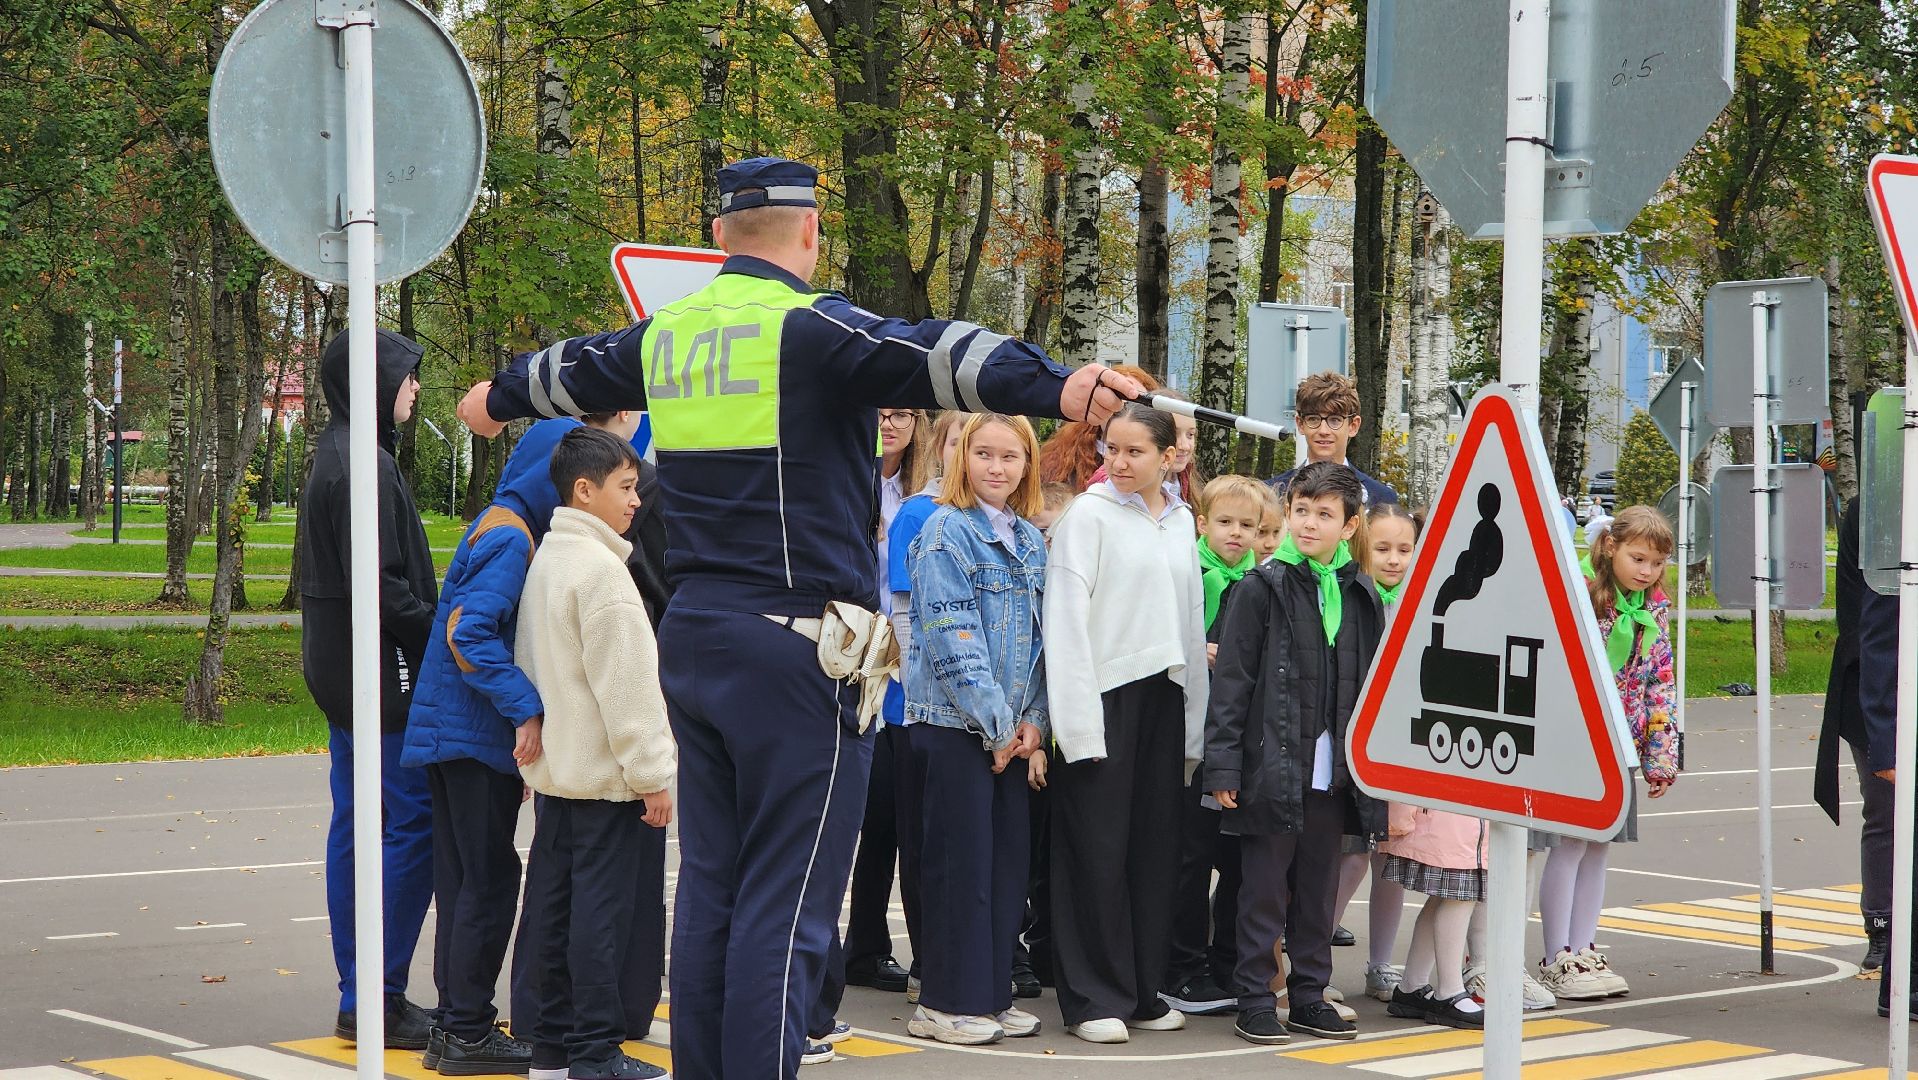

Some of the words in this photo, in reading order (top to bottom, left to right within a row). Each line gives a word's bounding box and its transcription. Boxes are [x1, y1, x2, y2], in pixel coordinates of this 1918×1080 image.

[648, 323, 761, 399] ДПС
[396, 646, 407, 666] JUST
[399, 668, 409, 680] DO
